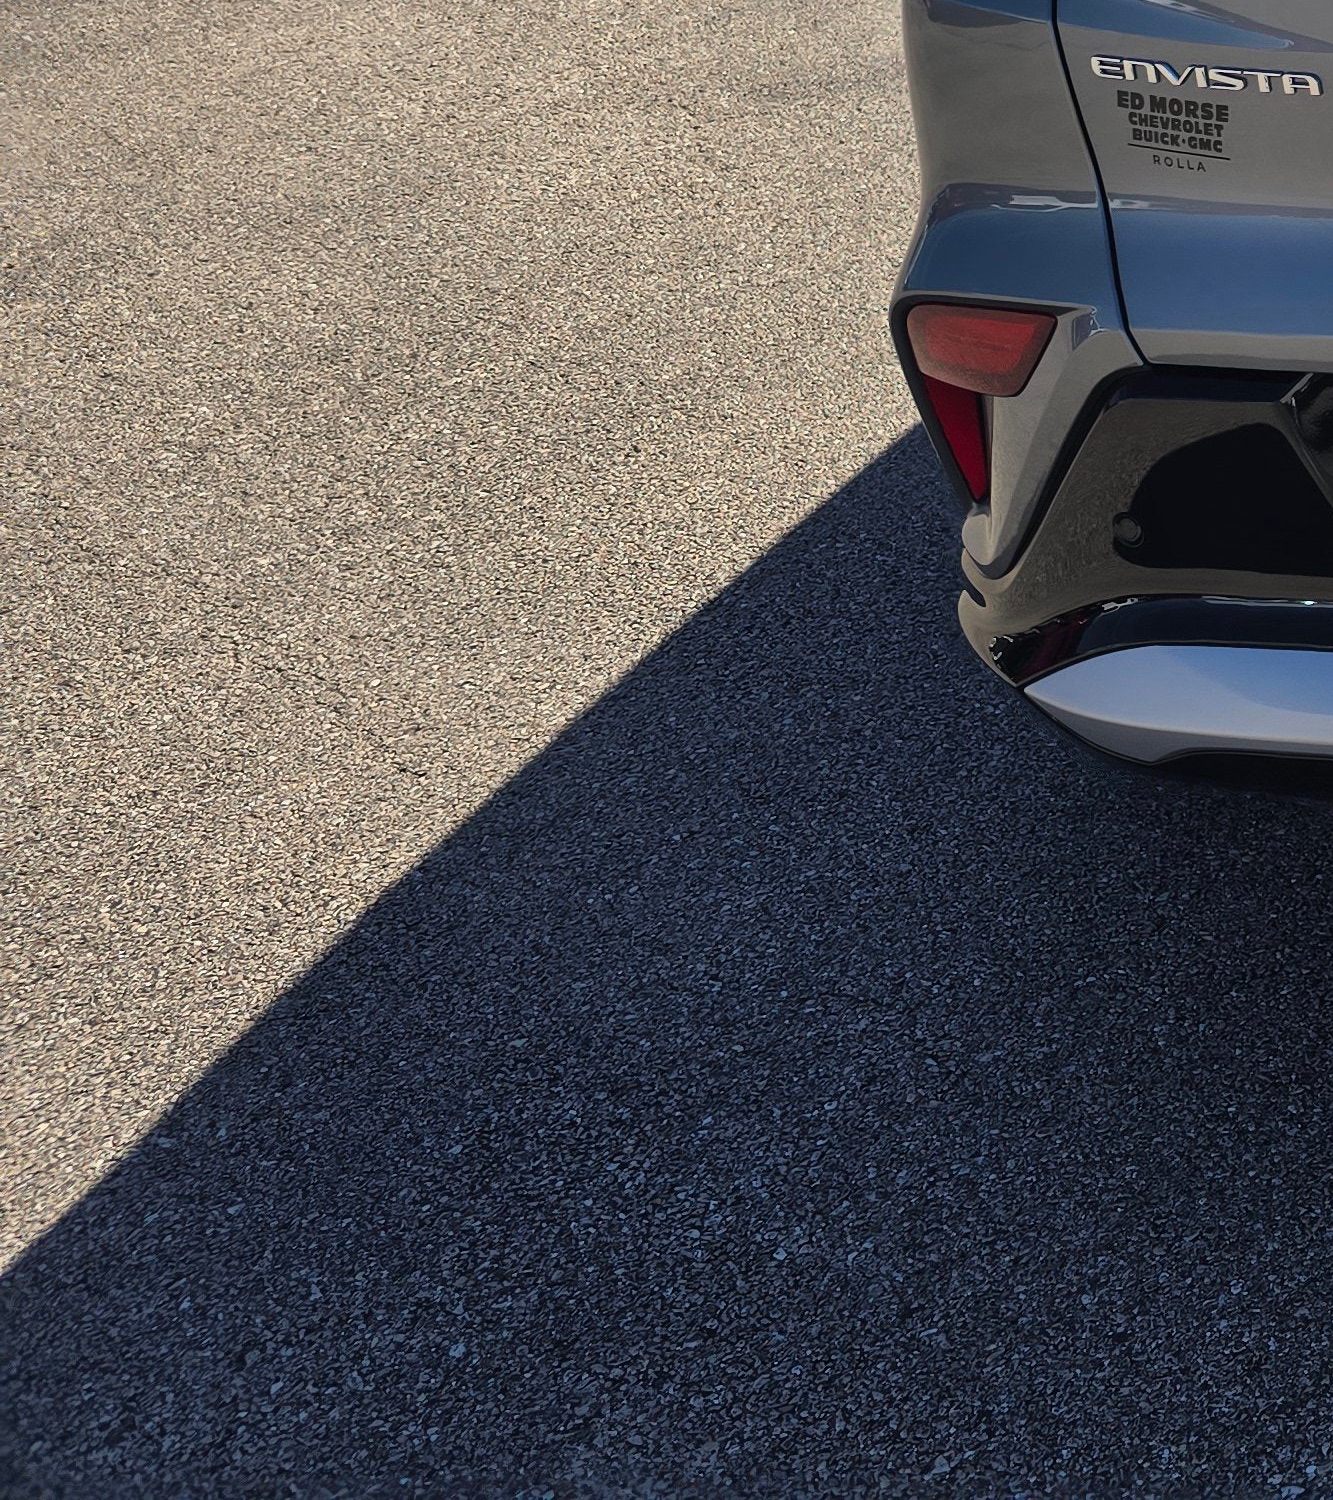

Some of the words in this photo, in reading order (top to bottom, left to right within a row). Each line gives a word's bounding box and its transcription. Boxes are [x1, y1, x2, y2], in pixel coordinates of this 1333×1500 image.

[1090, 53, 1324, 97] ENVISTA
[1116, 89, 1145, 110] ED
[1149, 93, 1230, 123] MORSE
[1127, 111, 1225, 138] CHEVROLET
[1152, 154, 1207, 173] ROLLA
